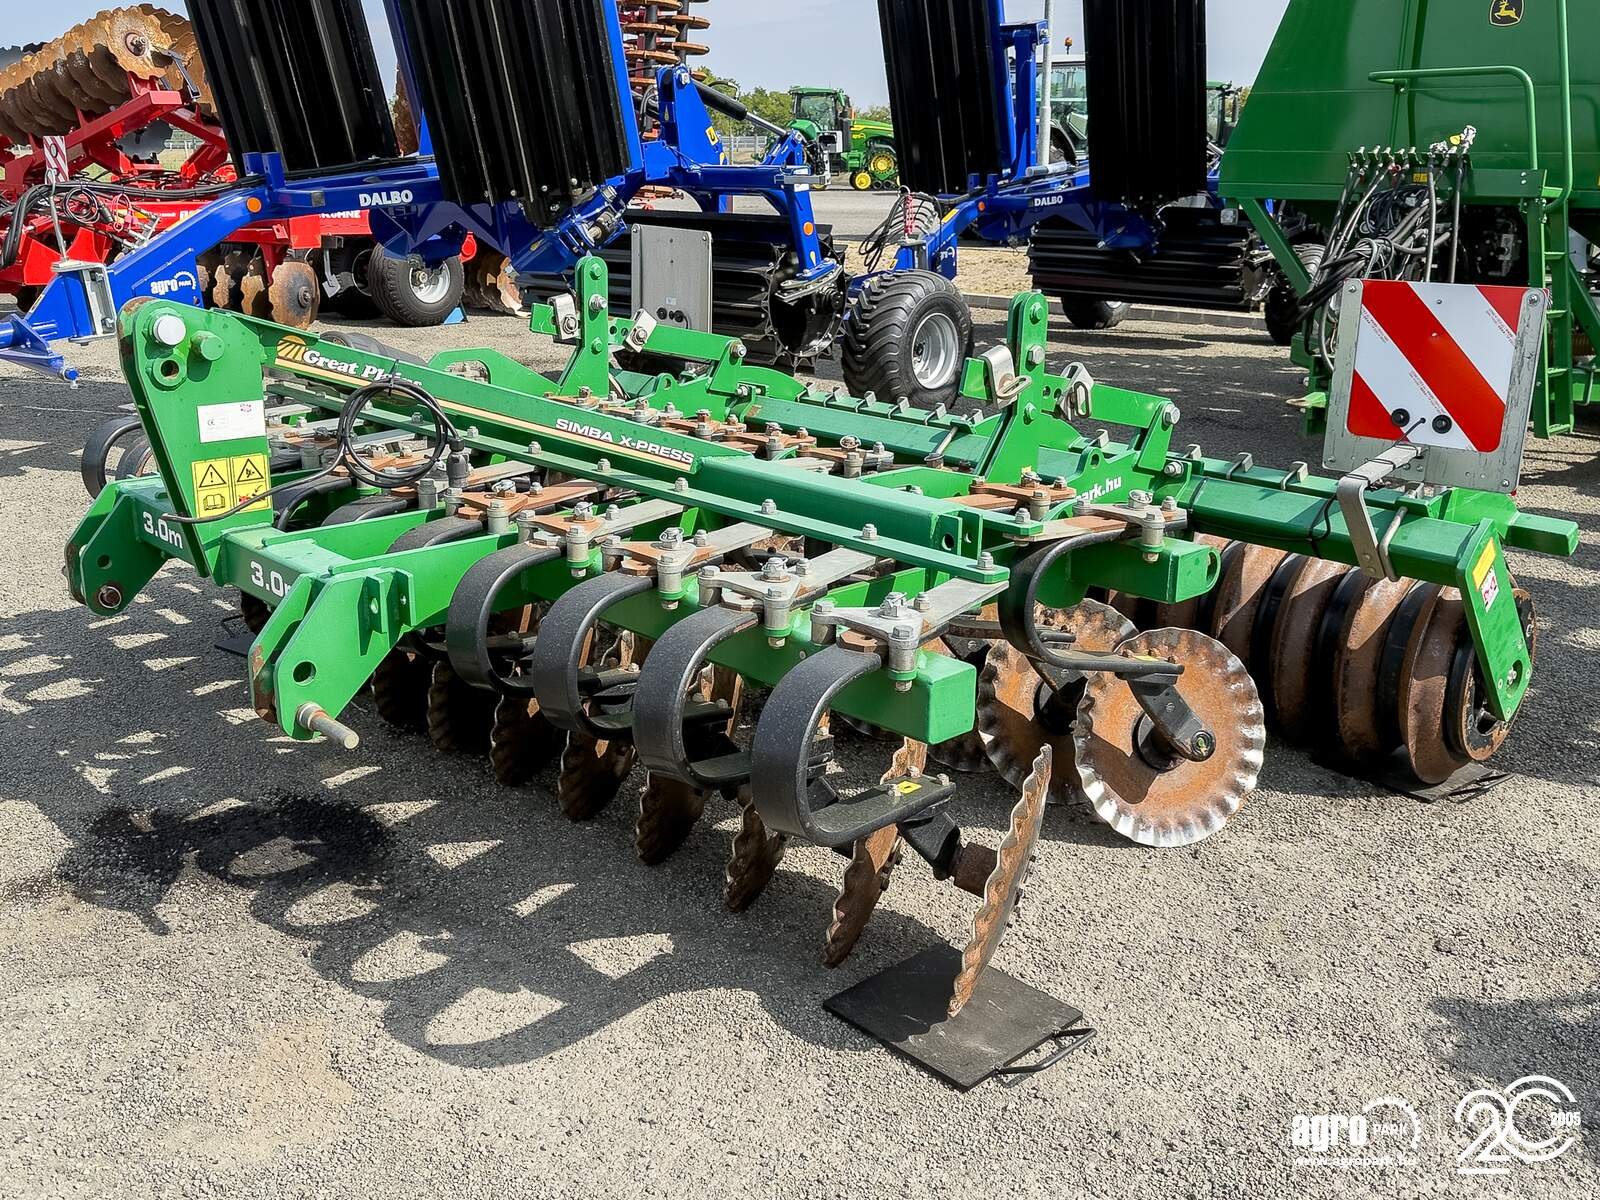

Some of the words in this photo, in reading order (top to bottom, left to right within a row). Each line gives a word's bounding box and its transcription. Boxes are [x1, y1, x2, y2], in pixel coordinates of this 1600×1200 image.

[359, 190, 413, 207] DALBO
[1034, 195, 1063, 207] DALBO
[151, 279, 178, 295] agro
[302, 350, 359, 377] Great
[555, 418, 614, 443] SIMBA
[618, 434, 694, 464] X-PRESS
[143, 511, 183, 550] 3.0m
